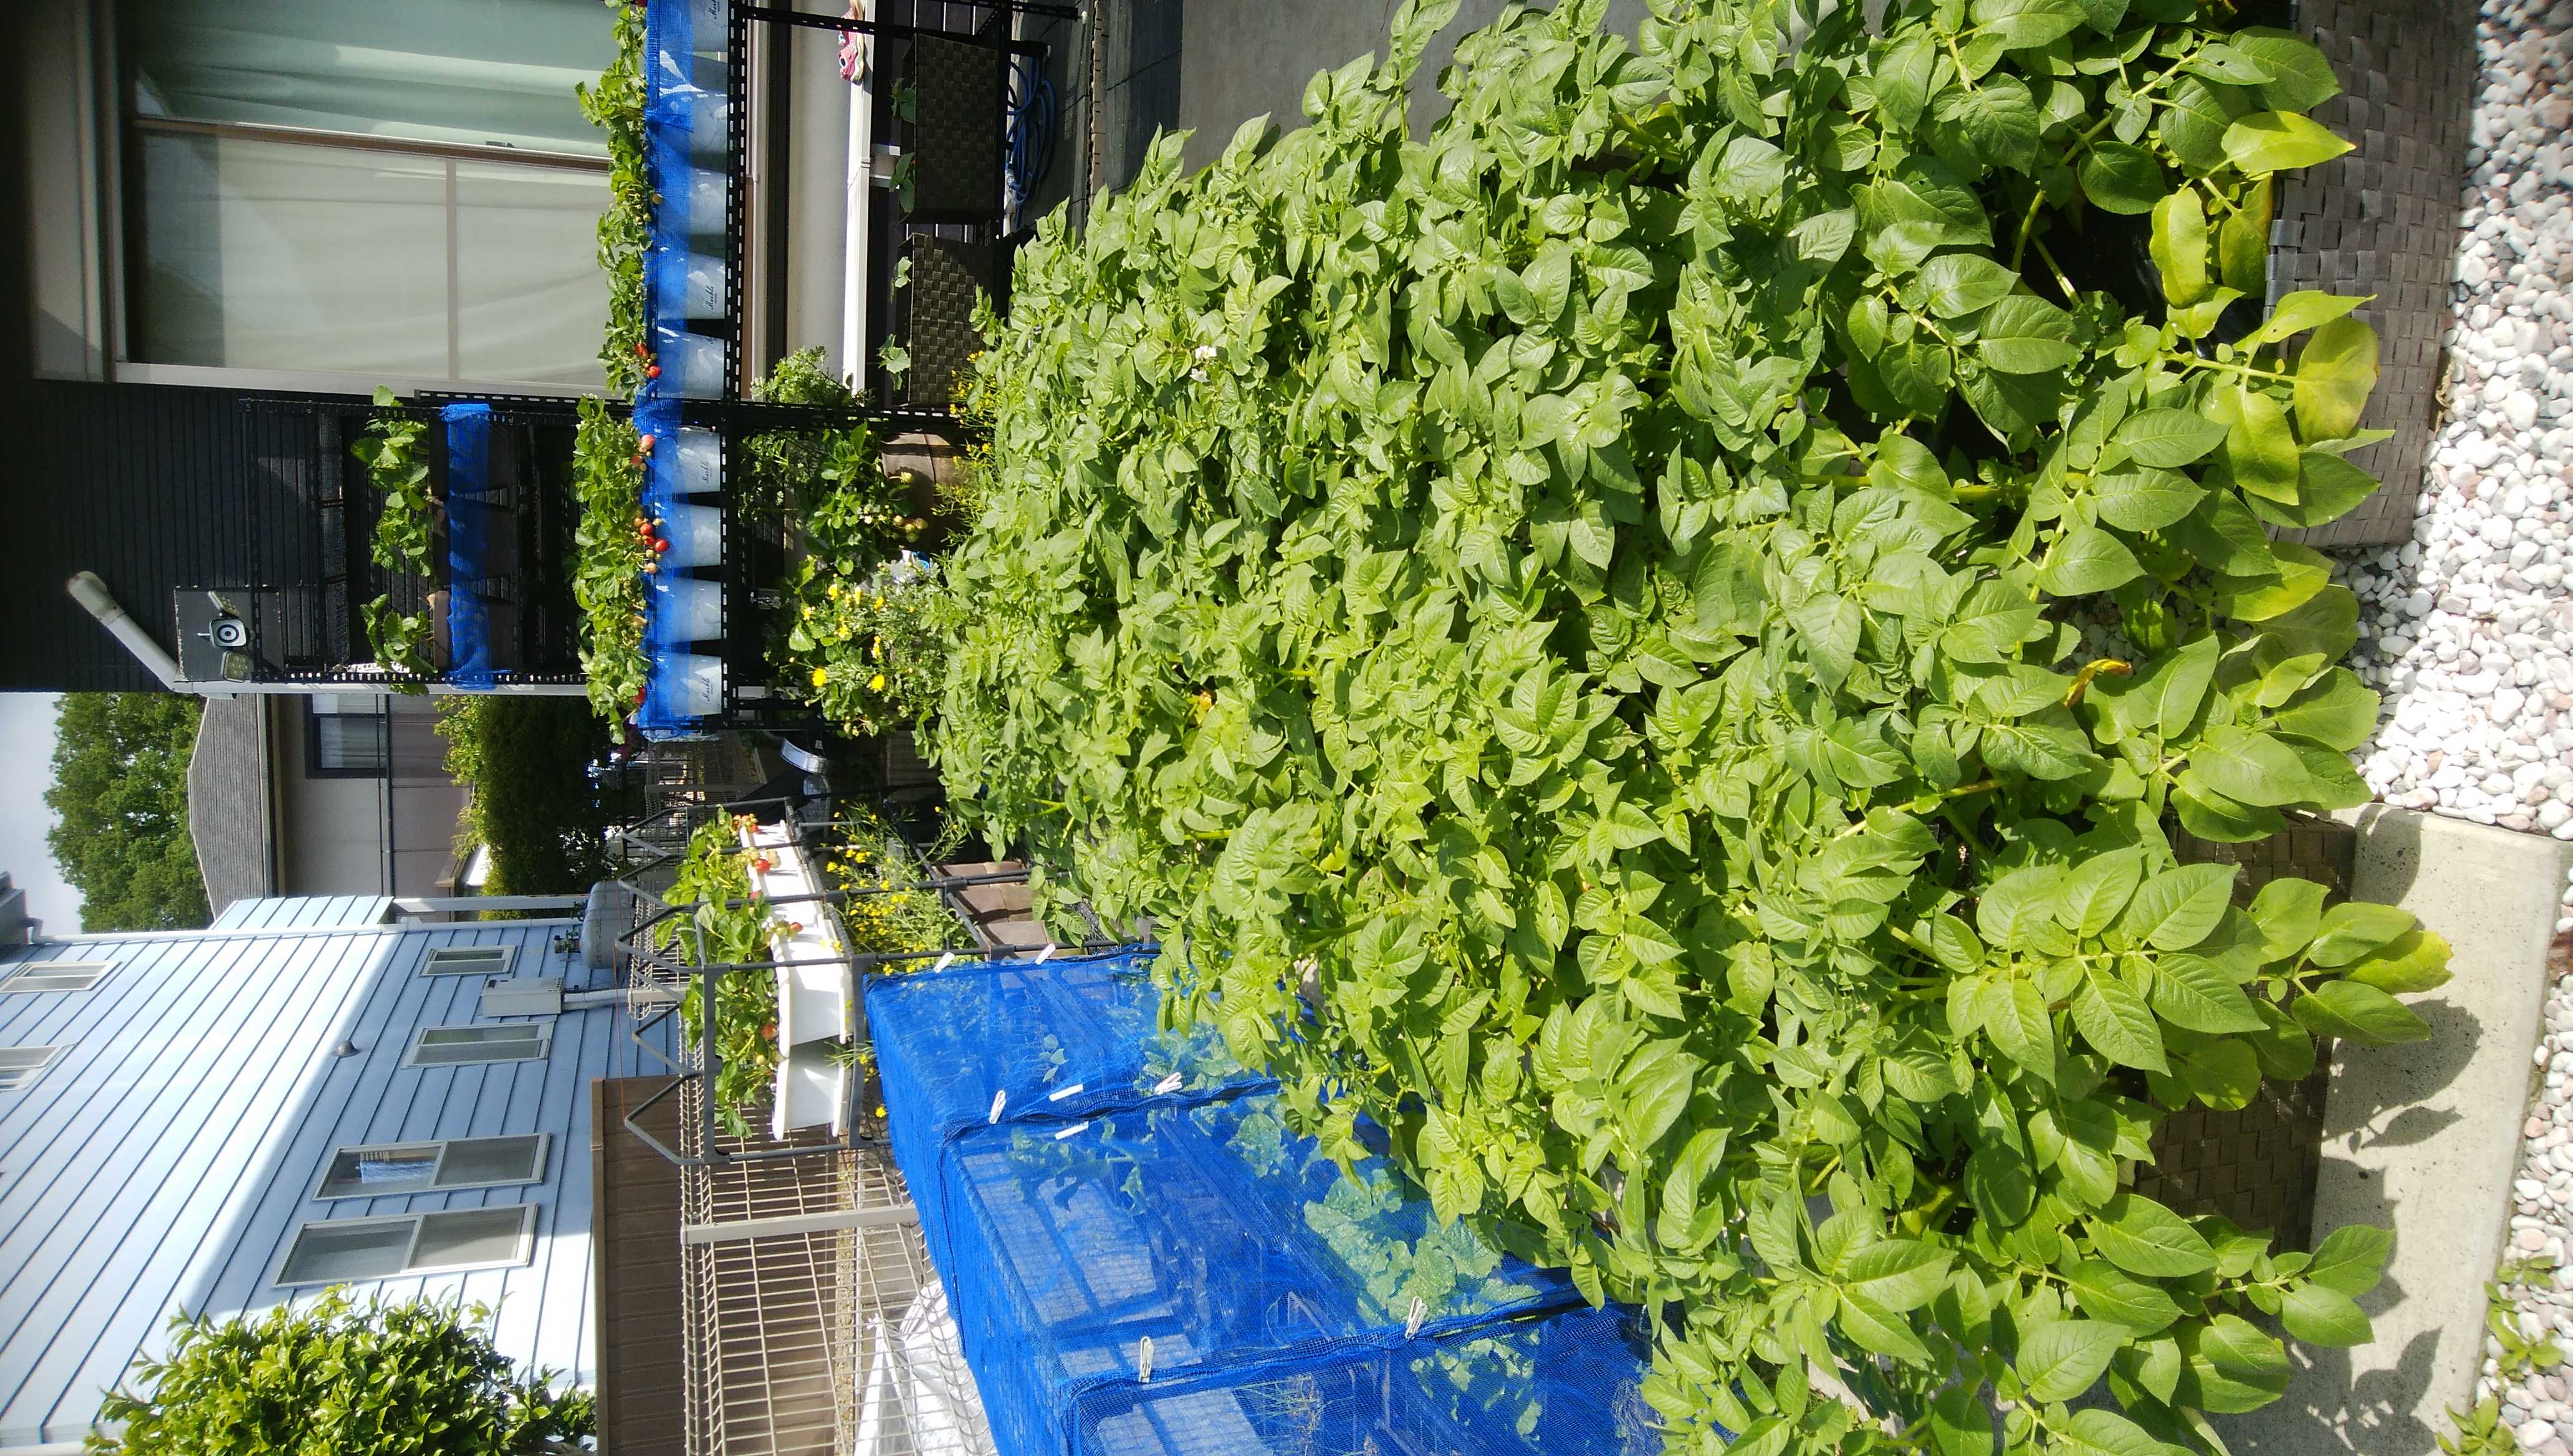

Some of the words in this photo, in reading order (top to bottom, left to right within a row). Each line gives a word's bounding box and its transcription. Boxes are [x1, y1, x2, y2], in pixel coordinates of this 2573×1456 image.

[704, 285, 714, 310] Marble
[700, 461, 709, 484] Marble
[702, 678, 710, 701] Marble
